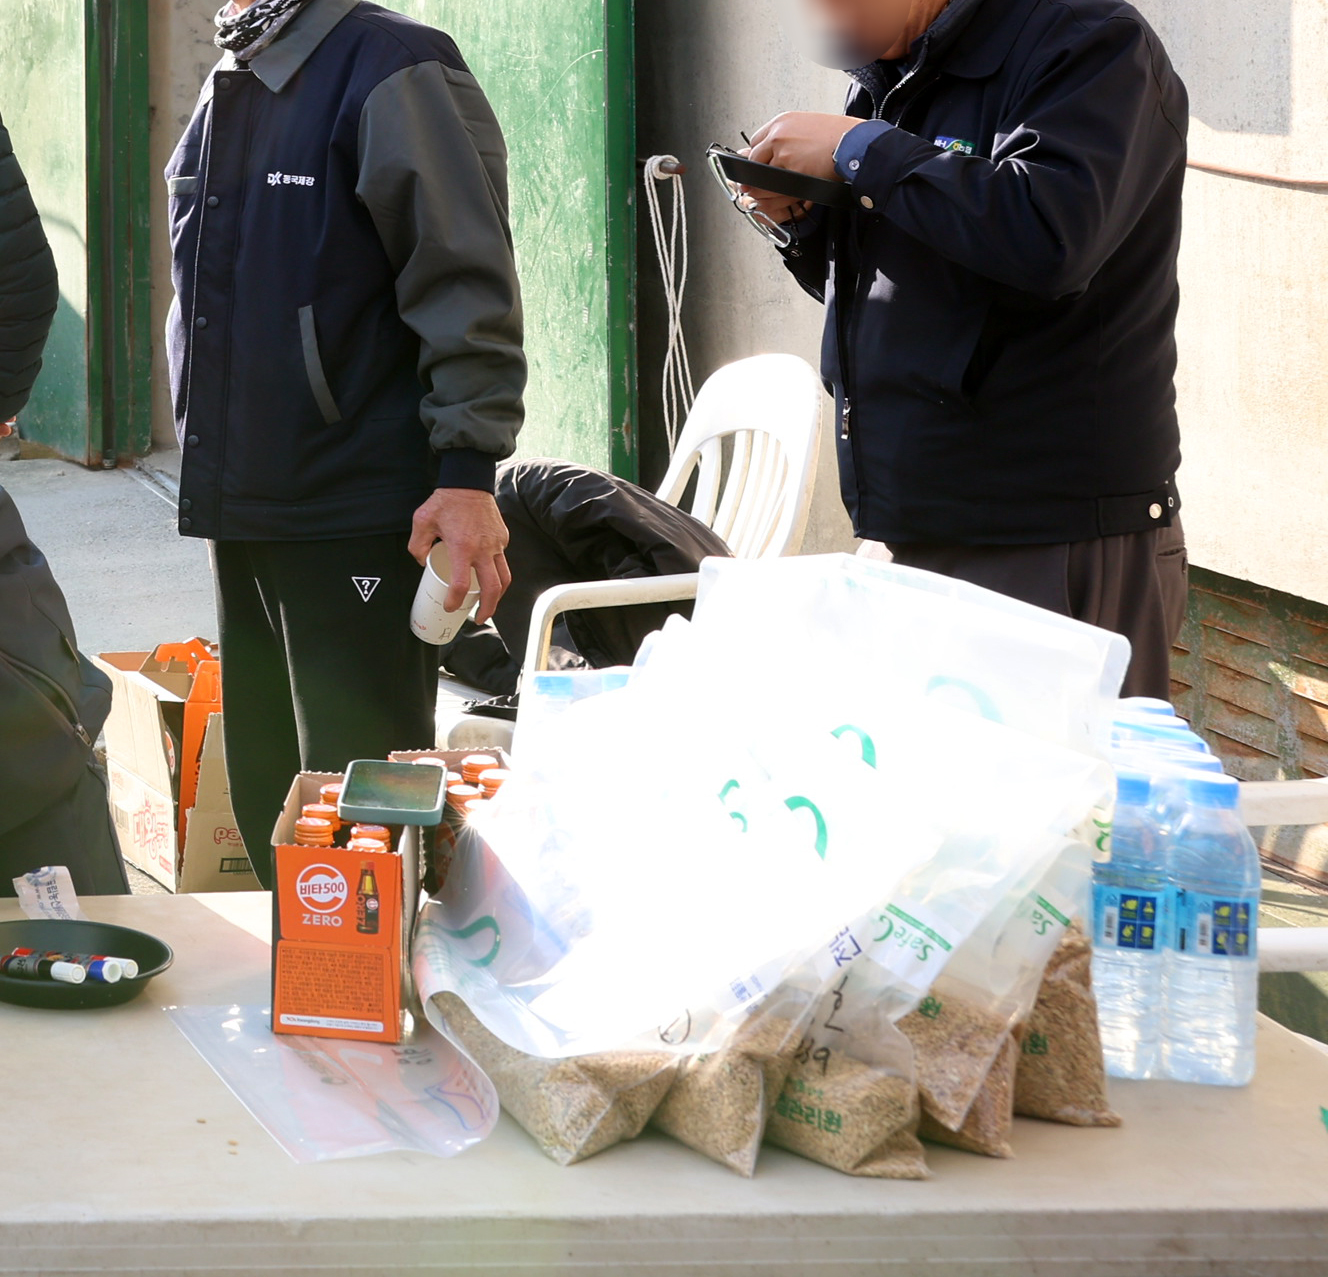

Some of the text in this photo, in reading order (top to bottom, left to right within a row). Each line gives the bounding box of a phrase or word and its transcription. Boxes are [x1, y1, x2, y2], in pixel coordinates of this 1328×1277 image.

[282, 174, 315, 186] 동국제강
[299, 881, 345, 895] 비타500
[302, 913, 343, 927] ZERO
